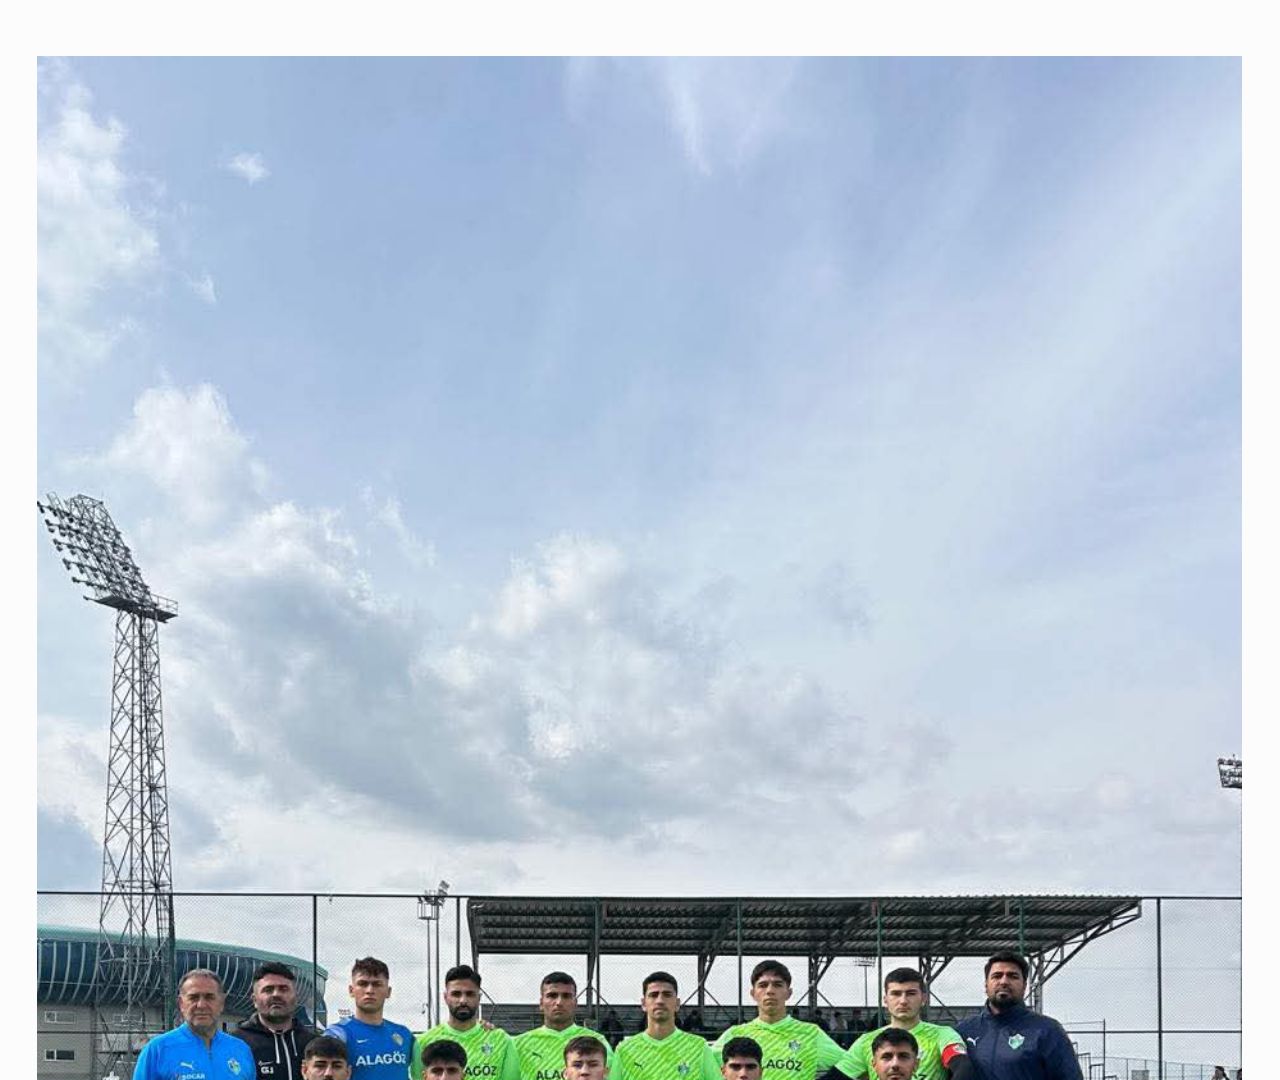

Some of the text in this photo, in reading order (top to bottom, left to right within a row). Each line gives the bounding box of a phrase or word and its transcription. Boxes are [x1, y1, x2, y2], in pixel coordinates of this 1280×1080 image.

[354, 1051, 407, 1066] ALAGÖZ
[764, 1056, 803, 1072] AGÖZ
[465, 1063, 497, 1077] AGÖZ
